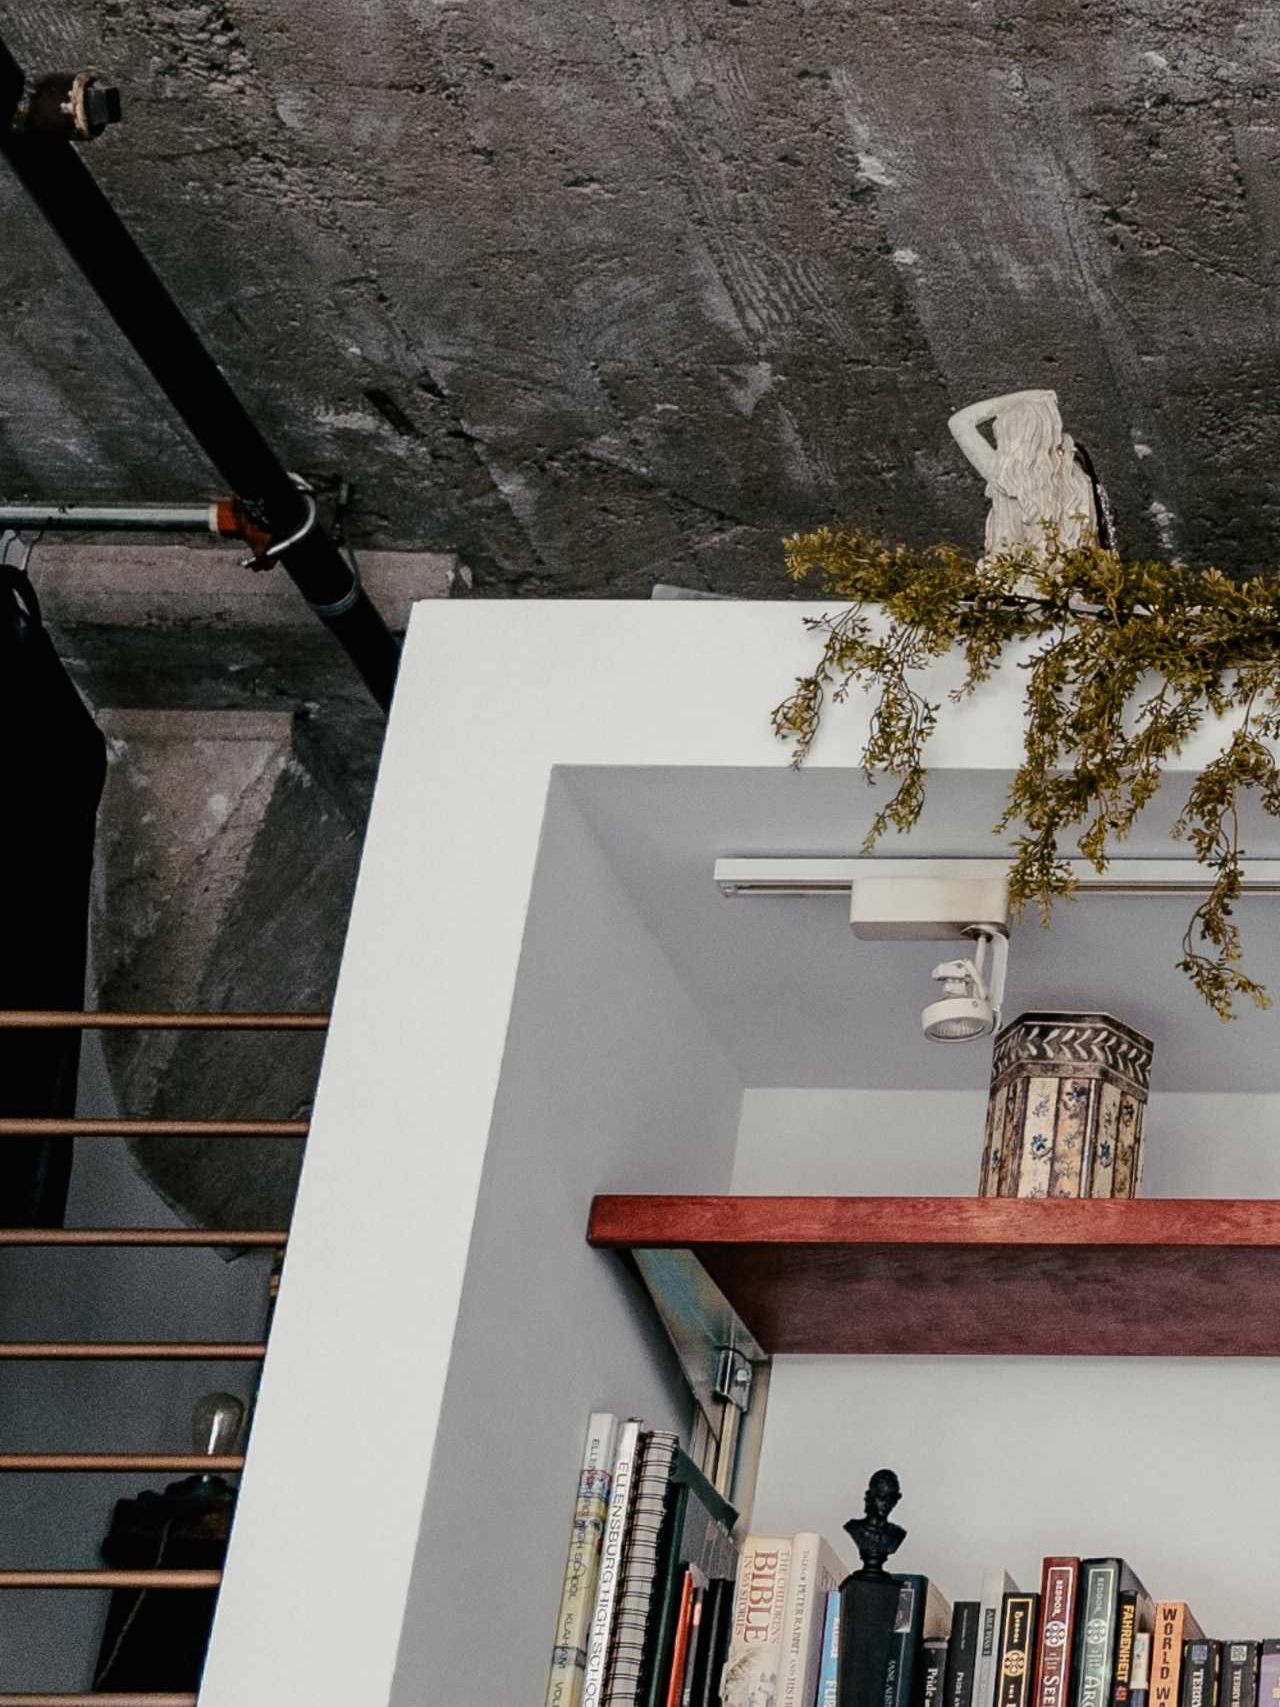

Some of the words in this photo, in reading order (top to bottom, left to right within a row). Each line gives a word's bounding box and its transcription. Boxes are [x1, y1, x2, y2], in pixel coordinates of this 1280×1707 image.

[600, 1461, 629, 1582] ELLENSBURG
[594, 1590, 611, 1636] HIGH
[743, 1549, 779, 1643] BIBLE
[1116, 1604, 1134, 1683] FAHRENHEIT
[1159, 1608, 1178, 1680] WORLD
[924, 1668, 938, 1696] Pride
[1115, 1685, 1126, 1701] 451
